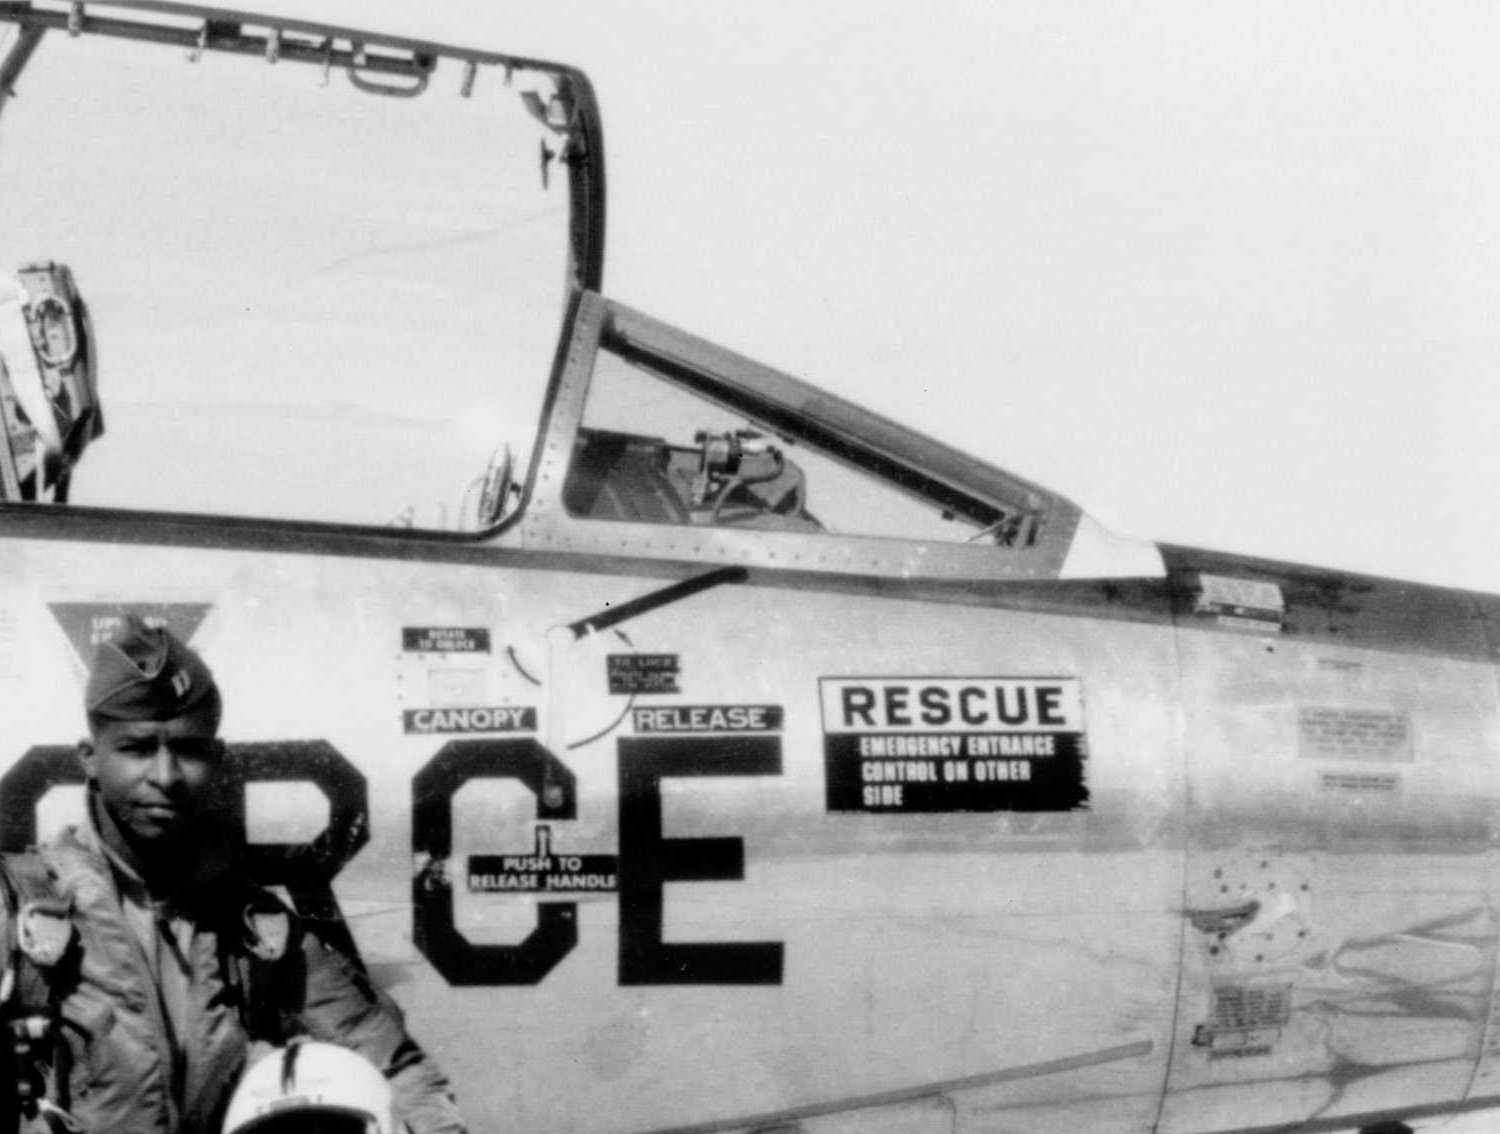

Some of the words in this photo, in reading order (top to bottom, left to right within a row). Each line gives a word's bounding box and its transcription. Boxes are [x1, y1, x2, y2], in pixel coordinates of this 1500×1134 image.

[841, 686, 1067, 727] RESCUE
[412, 708, 526, 731] CANOPY
[635, 706, 767, 731] RELEASE
[861, 735, 961, 757] EMERGENCY
[967, 735, 1055, 756] ENTRANCE
[862, 760, 938, 782] CONTROL
[943, 760, 969, 781] ON
[974, 760, 1032, 781] OTHER
[863, 785, 904, 806] SIDE
[503, 857, 551, 871] PUSH
[558, 857, 582, 871] TO
[470, 874, 538, 888] RELEASE
[546, 874, 616, 888] HANDLE
